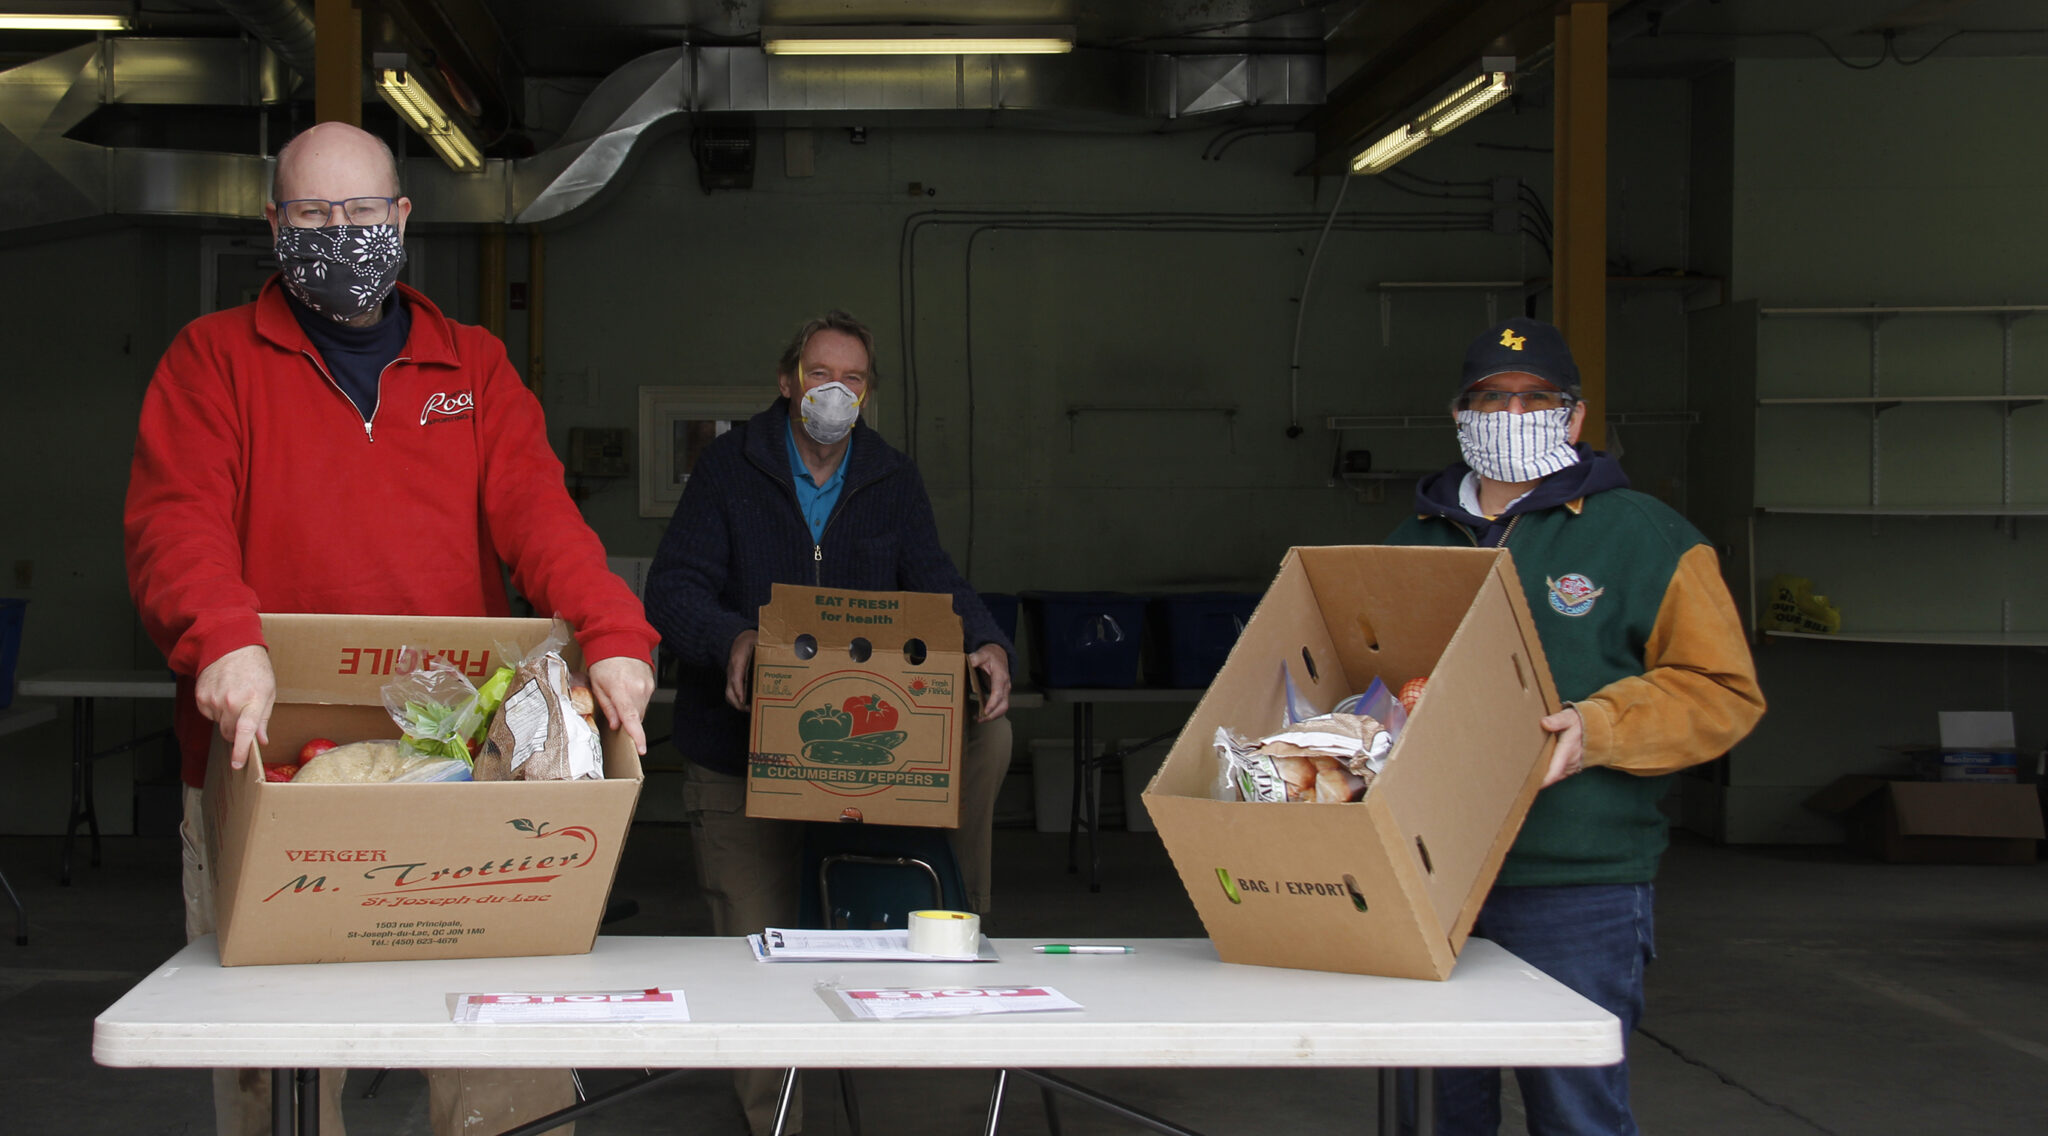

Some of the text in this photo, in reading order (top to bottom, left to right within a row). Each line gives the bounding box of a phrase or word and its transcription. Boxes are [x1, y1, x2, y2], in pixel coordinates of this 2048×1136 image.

[814, 595, 899, 610] EAT FRESH
[820, 611, 893, 625] for health
[338, 648, 490, 676] FRAGILE
[763, 671, 792, 679] Produce
[767, 766, 856, 783] CUCUMBERS
[868, 772, 933, 785] PEPPERS
[285, 849, 388, 863] VERGER
[262, 852, 579, 903] M. Trottier
[1237, 878, 1270, 893] BAG
[1285, 881, 1346, 896] EXPORT
[375, 921, 397, 929] 1503
[416, 920, 463, 928] Principale,
[347, 929, 430, 938] St-Joseph-du-Lac,
[391, 938, 414, 947] (450)
[497, 993, 645, 1003] STOP
[875, 989, 1019, 999] STOP
